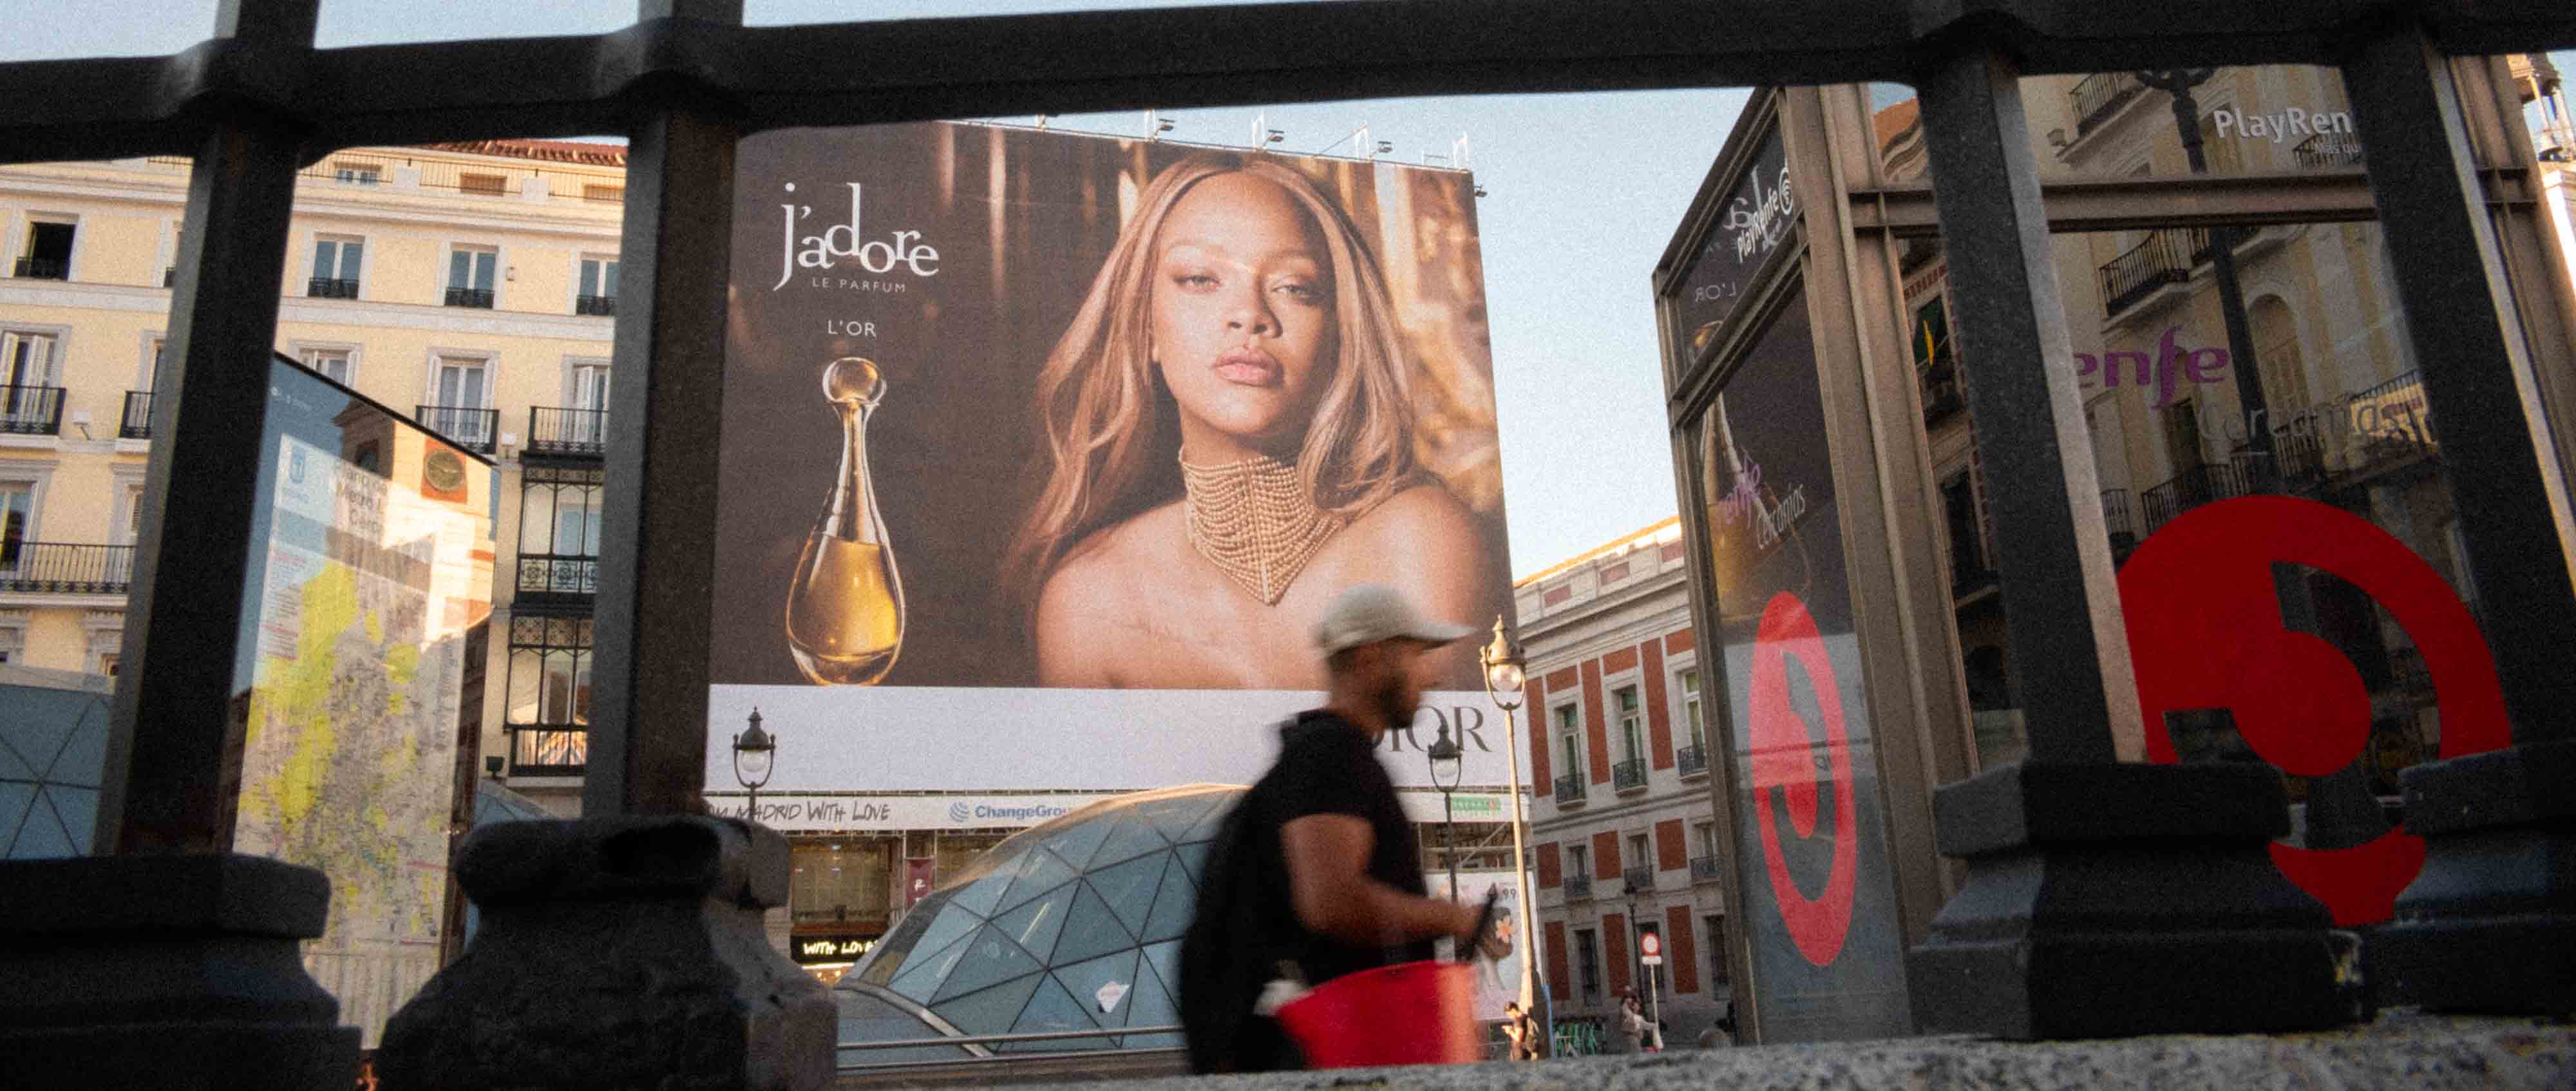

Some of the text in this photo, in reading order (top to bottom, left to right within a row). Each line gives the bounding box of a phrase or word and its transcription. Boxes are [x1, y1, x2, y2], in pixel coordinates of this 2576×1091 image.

[2213, 107, 2352, 144] PlayRen
[2342, 143, 2360, 160] qu
[773, 182, 939, 291] j'adore
[812, 277, 905, 293] LE PARFUM
[828, 320, 876, 337] L'OR
[2072, 325, 2232, 411] enfe
[1372, 705, 1493, 753] IOR
[735, 803, 802, 821] MADRID
[807, 801, 846, 822] WITH
[852, 801, 892, 821] LOVE
[974, 805, 1066, 820] ChangeGro
[803, 941, 837, 955] WITH
